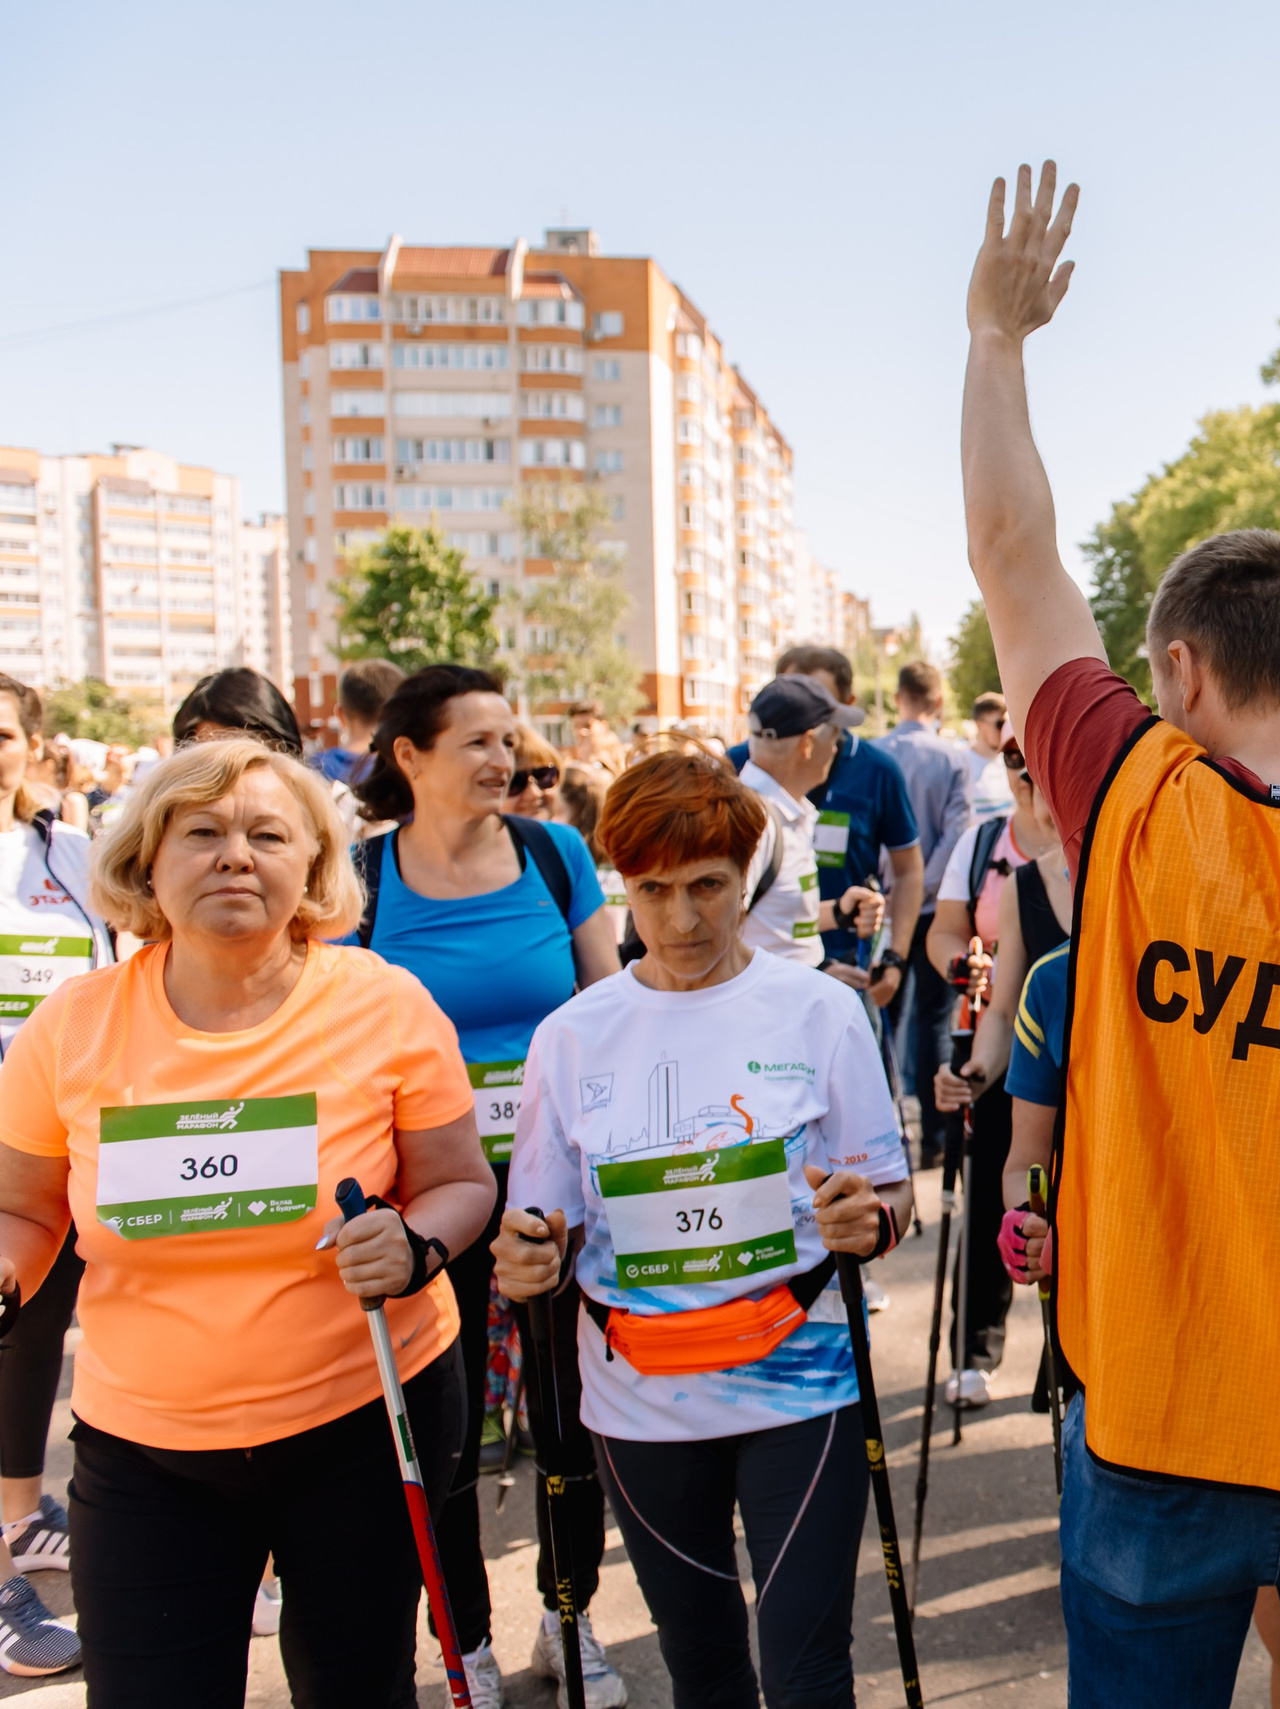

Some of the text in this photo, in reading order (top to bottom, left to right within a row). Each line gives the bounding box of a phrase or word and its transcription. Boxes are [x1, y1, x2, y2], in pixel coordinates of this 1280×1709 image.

[21, 969, 53, 983] 349
[176, 1122, 219, 1130] МАРАФОН
[845, 1153, 868, 1165] 2019
[180, 1154, 238, 1180] 360
[127, 1214, 163, 1227] СБЕР
[675, 1208, 723, 1233] 376
[641, 1264, 669, 1275] СБЕР
